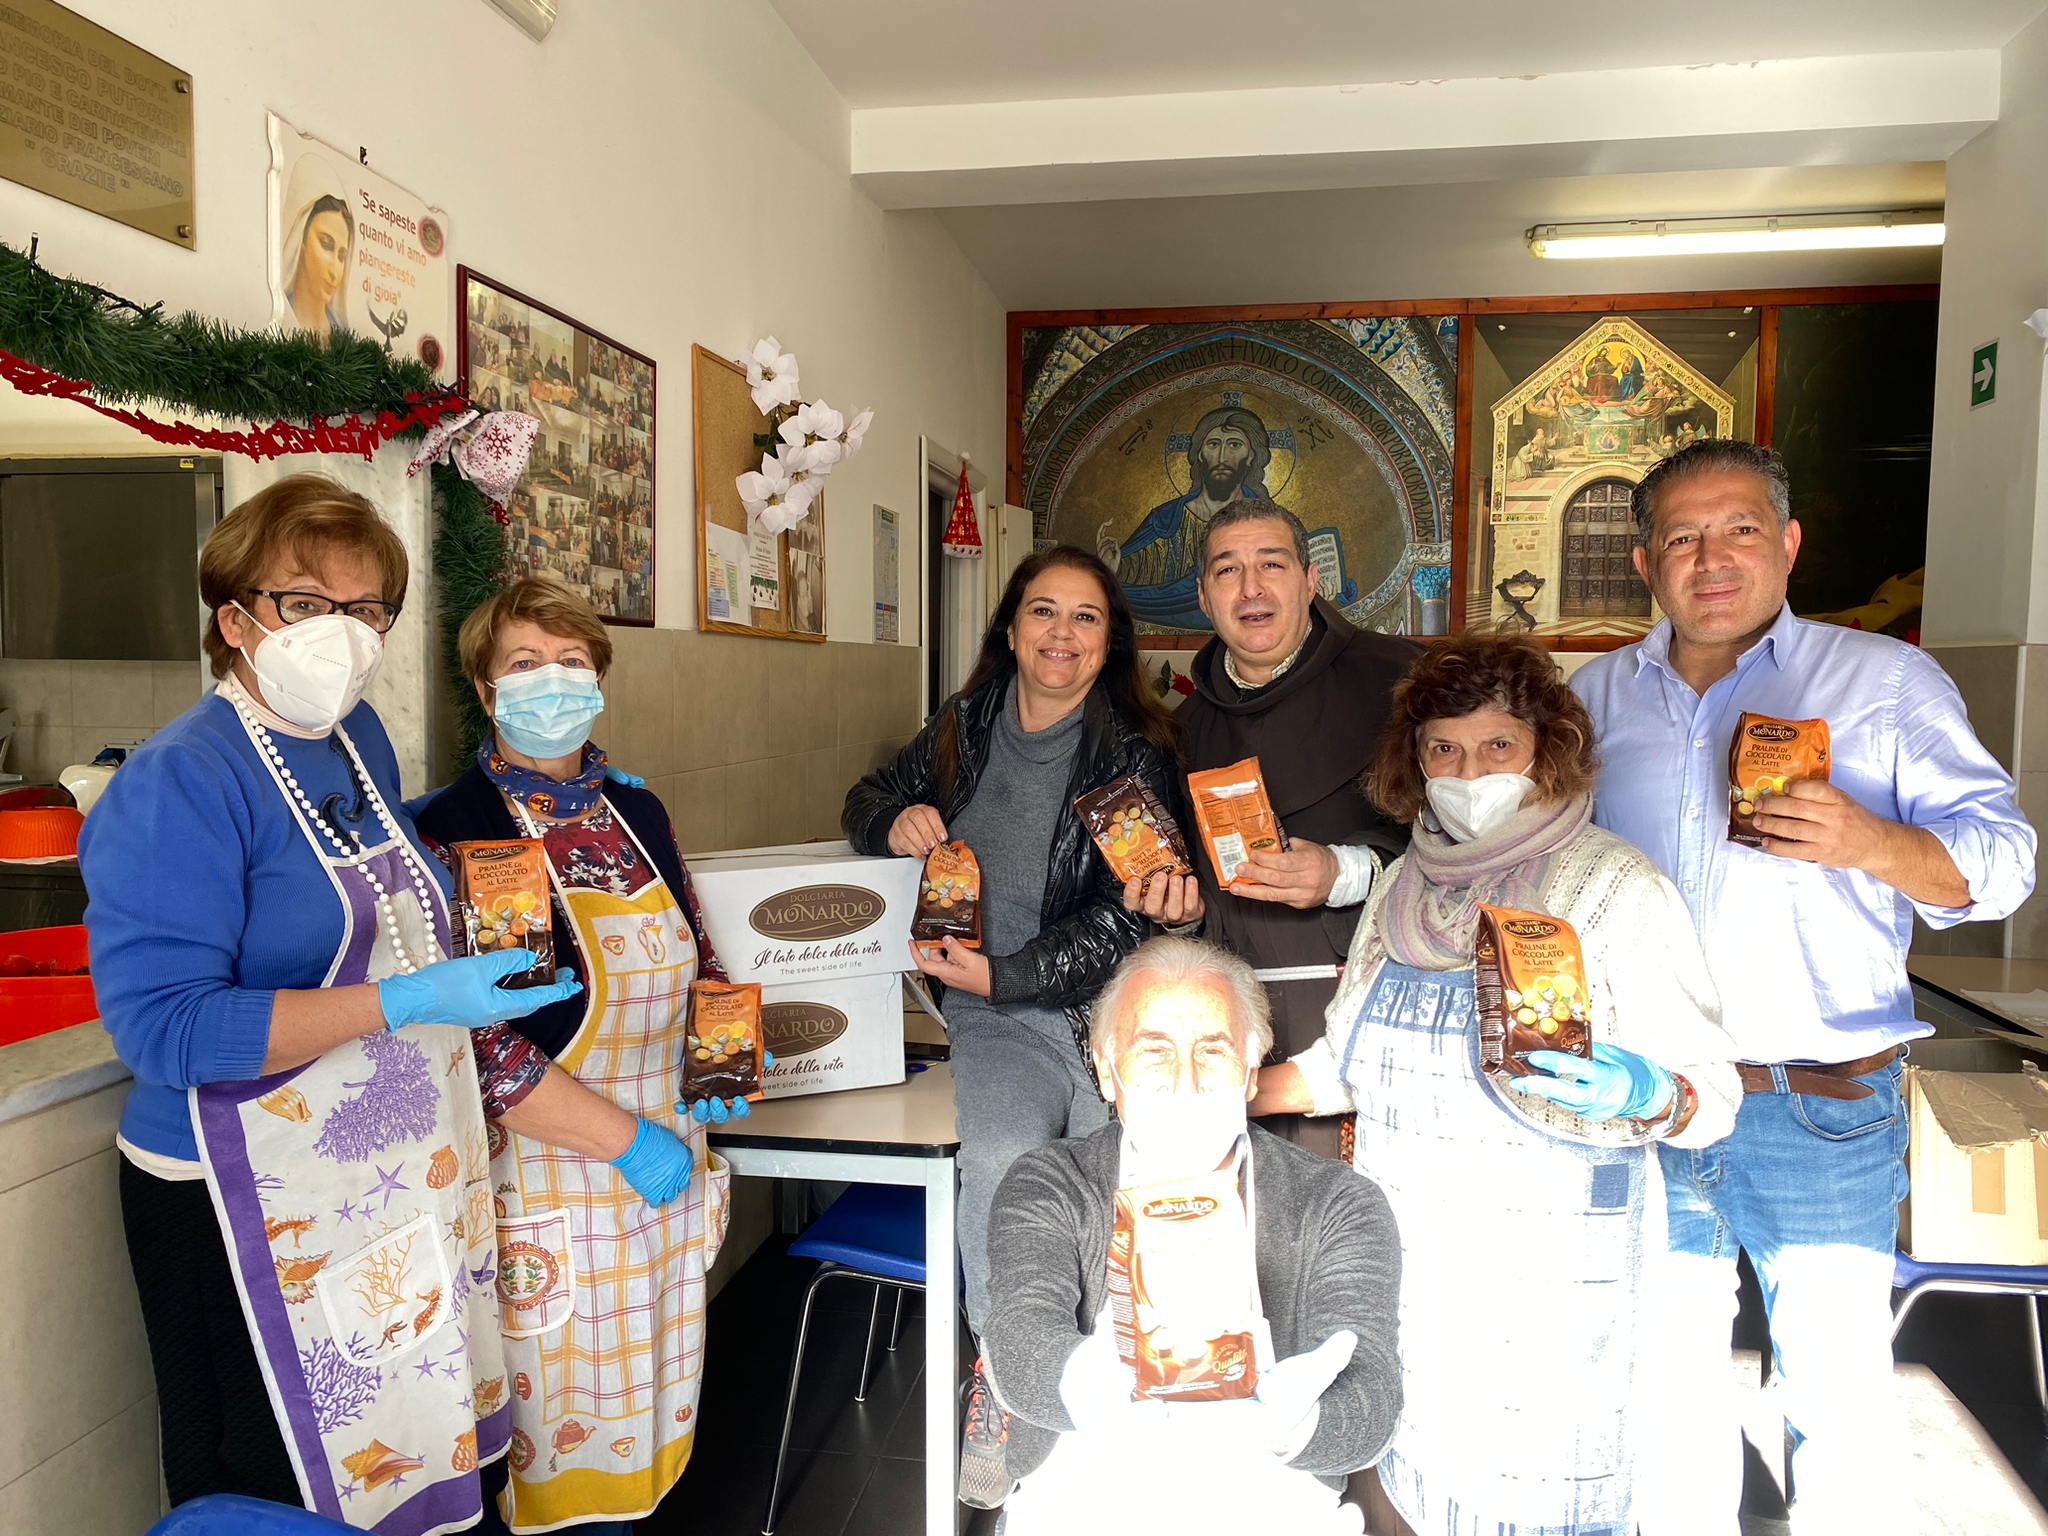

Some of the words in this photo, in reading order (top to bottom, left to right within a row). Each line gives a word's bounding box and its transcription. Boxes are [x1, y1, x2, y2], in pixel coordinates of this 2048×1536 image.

[0, 32, 92, 91] ANCESCO
[88, 48, 121, 79] DEL
[13, 63, 45, 92] PIO
[51, 80, 62, 101] E
[66, 89, 187, 158] CARITATEVOLE
[0, 82, 64, 125] MANTE
[68, 112, 98, 139] DEI
[102, 126, 161, 167] POVERI
[0, 104, 58, 144] ZIARIO
[63, 131, 183, 198] FRANCESCANO
[41, 147, 116, 193] GRAZIE
[359, 188, 376, 213] "Se
[379, 204, 416, 235] sapeste
[359, 222, 393, 249] quanto
[396, 239, 405, 256] vi
[407, 245, 427, 266] amo
[359, 248, 416, 287] piangereste
[362, 276, 371, 294] di
[374, 283, 401, 306] gioia"
[1752, 726, 1795, 740] MONARDO
[1745, 750, 1791, 761] CIOCCOLATO
[1752, 744, 1780, 753] PRALINE
[1761, 759, 1780, 767] LATTE
[471, 846, 523, 858] MONARDO
[473, 868, 528, 880] CIOCCOLATO
[478, 862, 513, 873] PRALINE
[790, 891, 845, 903] DOLCIARIA
[759, 900, 873, 926] MONARDO
[1505, 922, 1556, 935] MONARDO
[1511, 948, 1564, 958] CIOCCOLATO
[1514, 941, 1547, 950] PRALINE
[749, 947, 772, 970] Il
[773, 949, 795, 965] lato
[798, 945, 828, 961] dolce
[830, 942, 858, 958] della
[862, 940, 882, 955] vita
[1532, 958, 1554, 966] LATTE
[796, 965, 819, 974] sweet
[821, 962, 837, 971] side
[839, 961, 847, 969] of
[761, 1008, 807, 1020] LCIARIA
[761, 1017, 835, 1043] NARDO
[790, 1059, 820, 1075] della
[823, 1056, 844, 1072] vita
[782, 1080, 798, 1088] side
[800, 1078, 808, 1086] of
[811, 1077, 824, 1085] life
[1146, 1199, 1215, 1216] MONARDO
[1211, 1348, 1248, 1374] Quality
